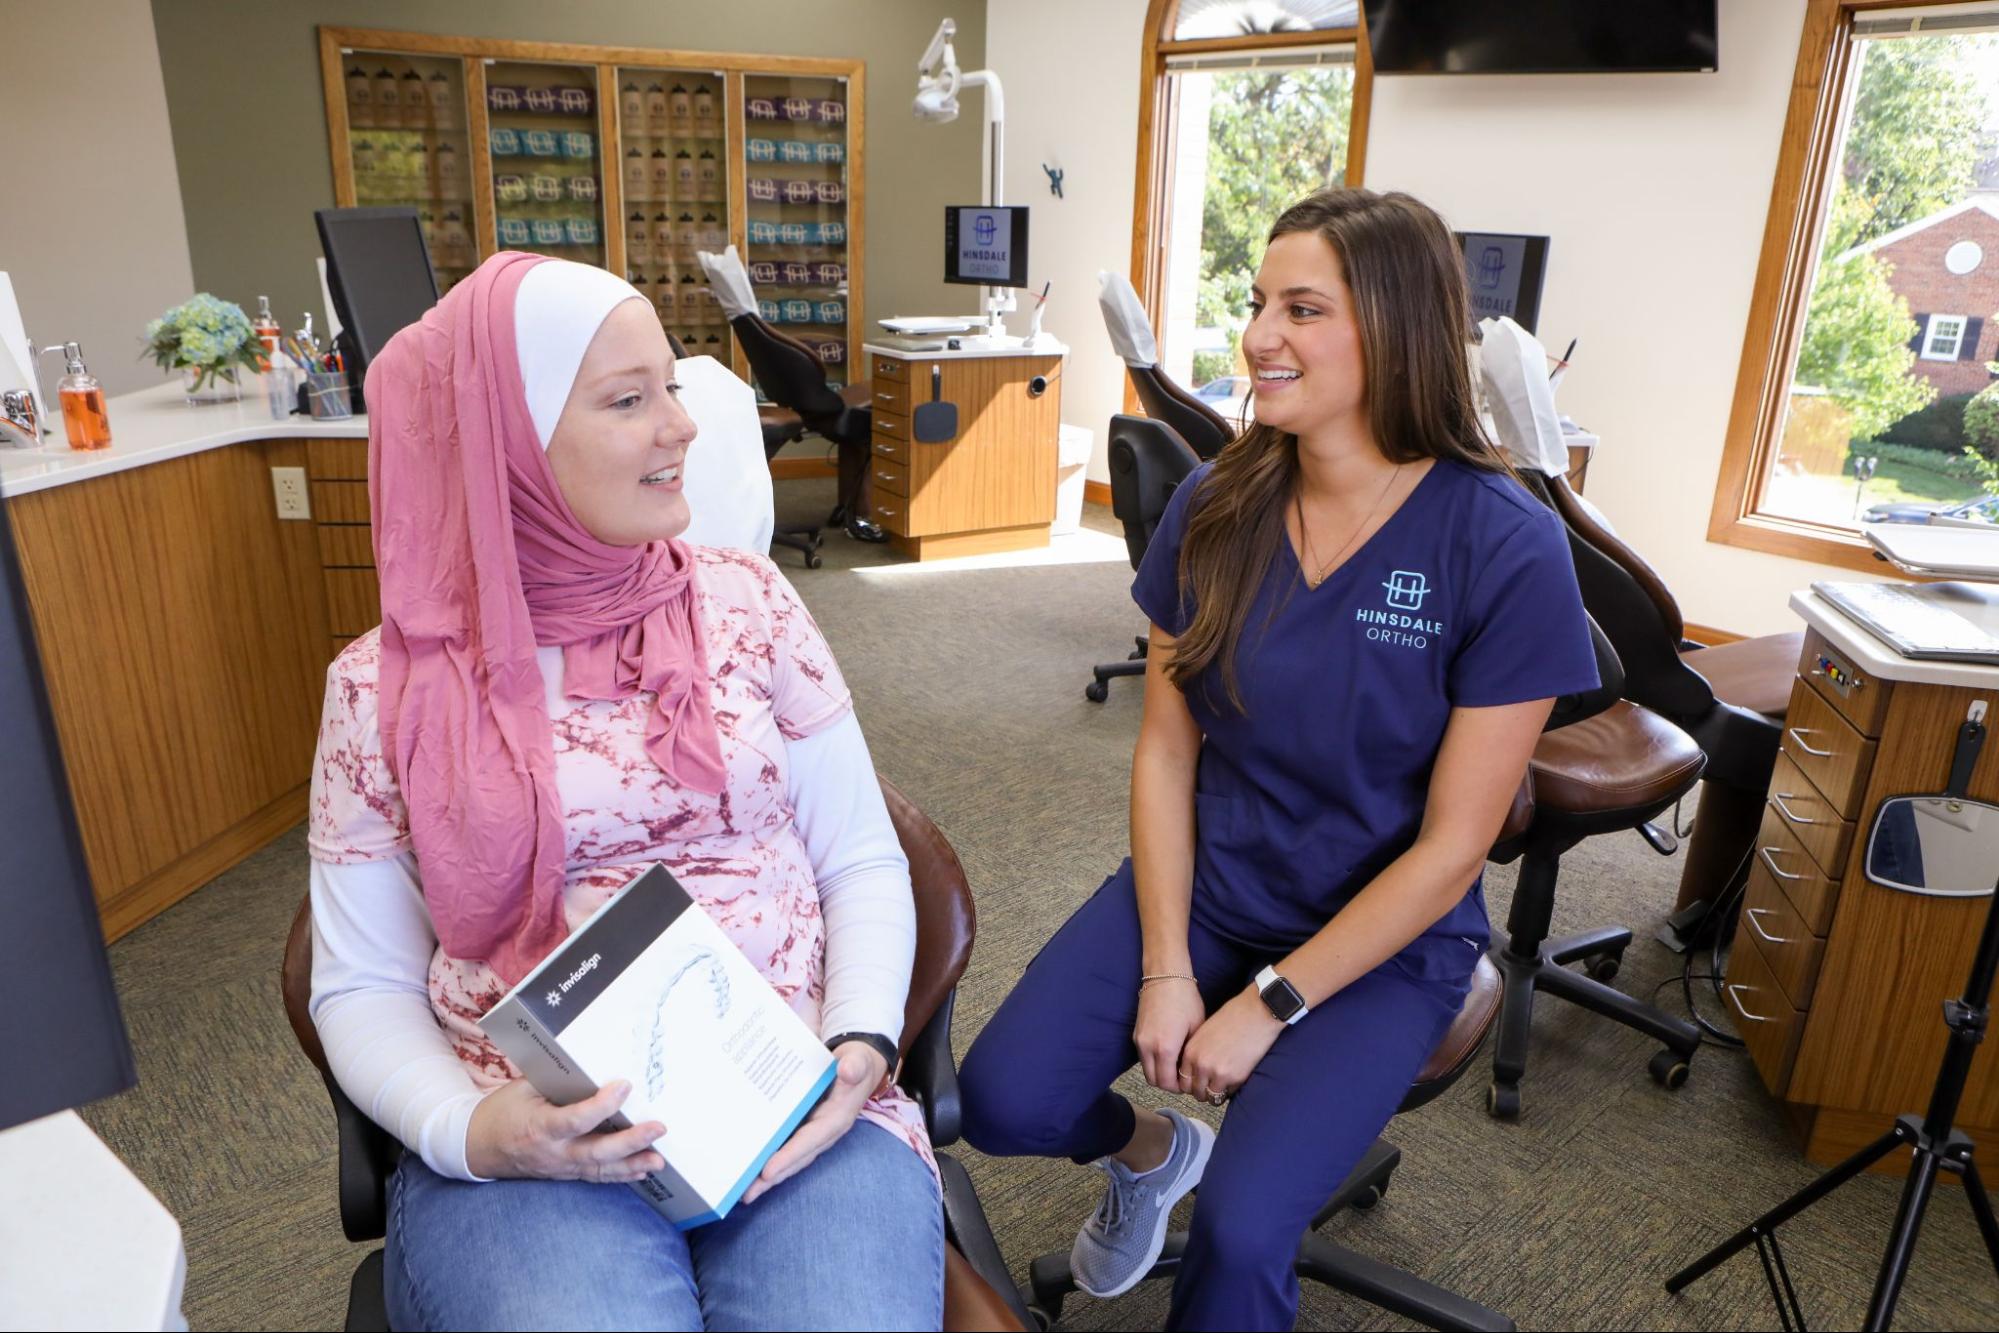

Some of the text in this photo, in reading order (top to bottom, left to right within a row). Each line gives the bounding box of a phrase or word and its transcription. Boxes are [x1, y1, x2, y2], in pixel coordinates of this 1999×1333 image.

[963, 249, 1007, 262] HINSDALE
[1470, 295, 1512, 313] NSDALE
[1356, 608, 1443, 635] HINSDALE
[1366, 627, 1427, 649] ORTHO
[558, 952, 602, 993] invisalign
[531, 1033, 570, 1075] invisalign
